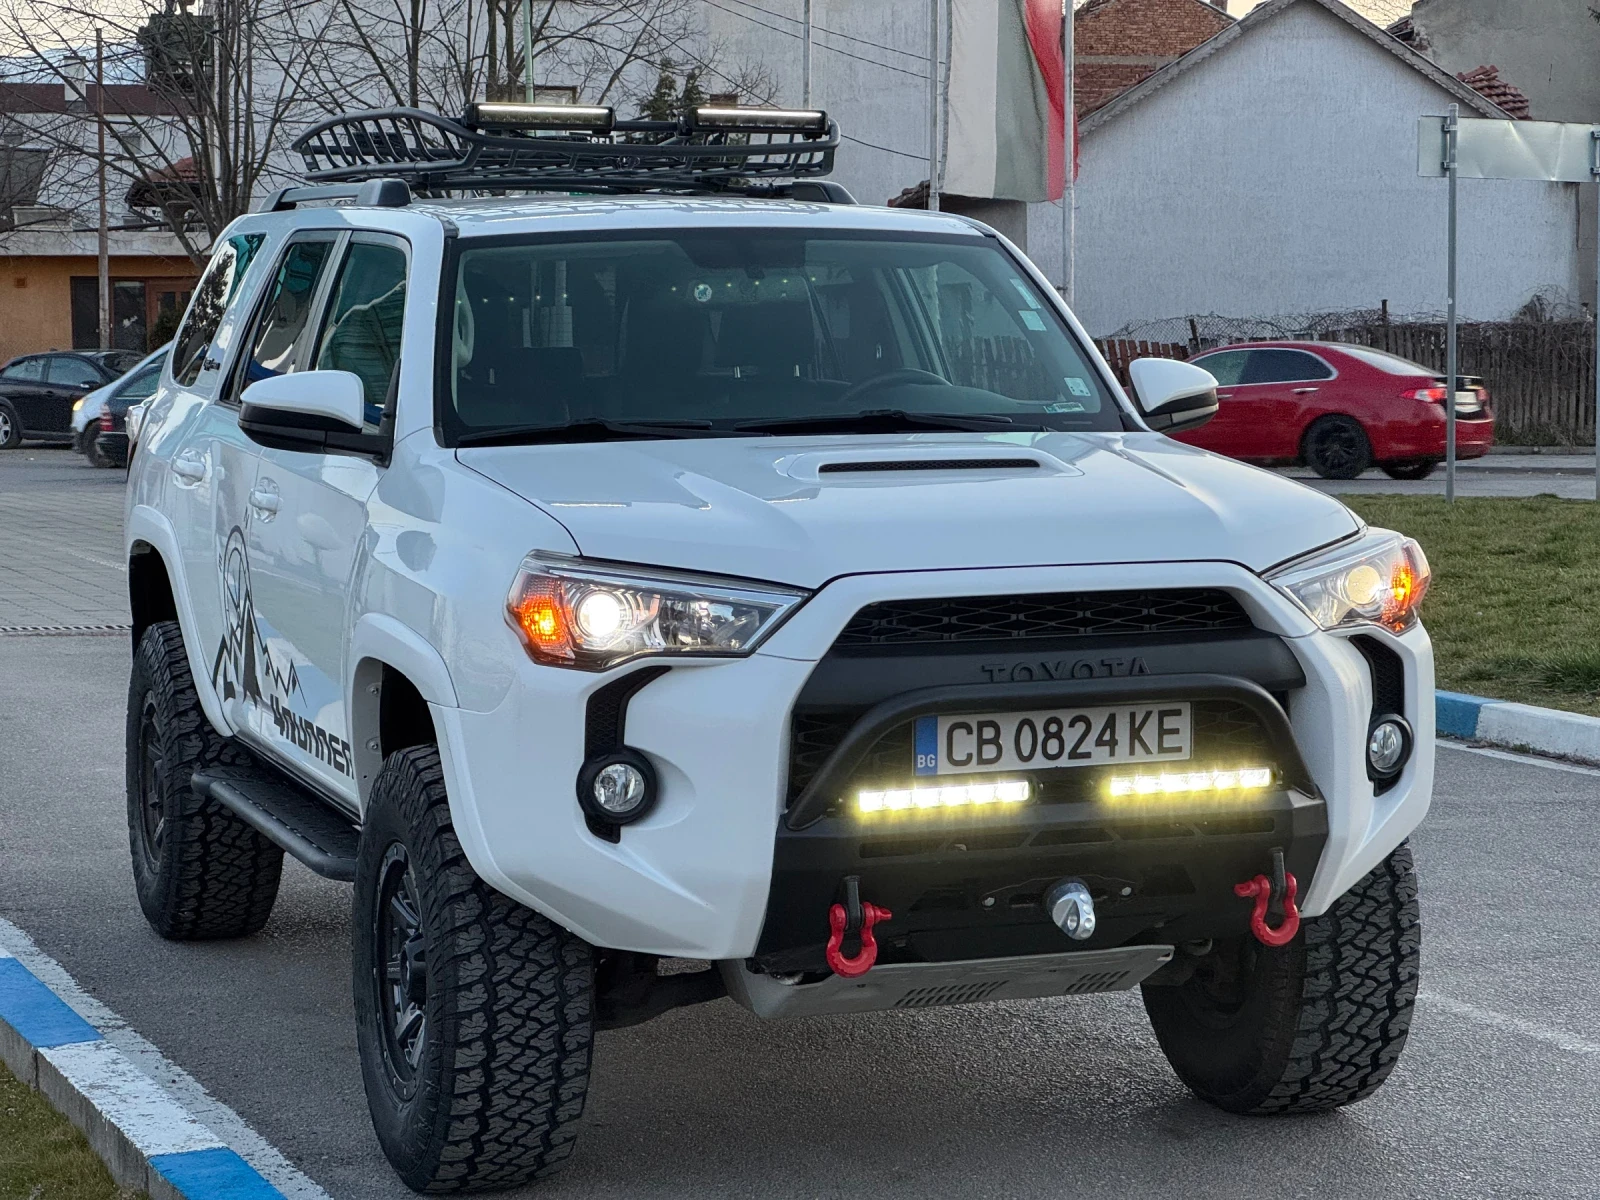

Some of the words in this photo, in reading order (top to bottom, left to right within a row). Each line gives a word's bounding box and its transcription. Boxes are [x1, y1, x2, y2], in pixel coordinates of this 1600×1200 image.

[946, 721, 1003, 767] CB
[1014, 712, 1119, 763] 0824
[1128, 708, 1183, 757] KE
[917, 753, 936, 768] BG
